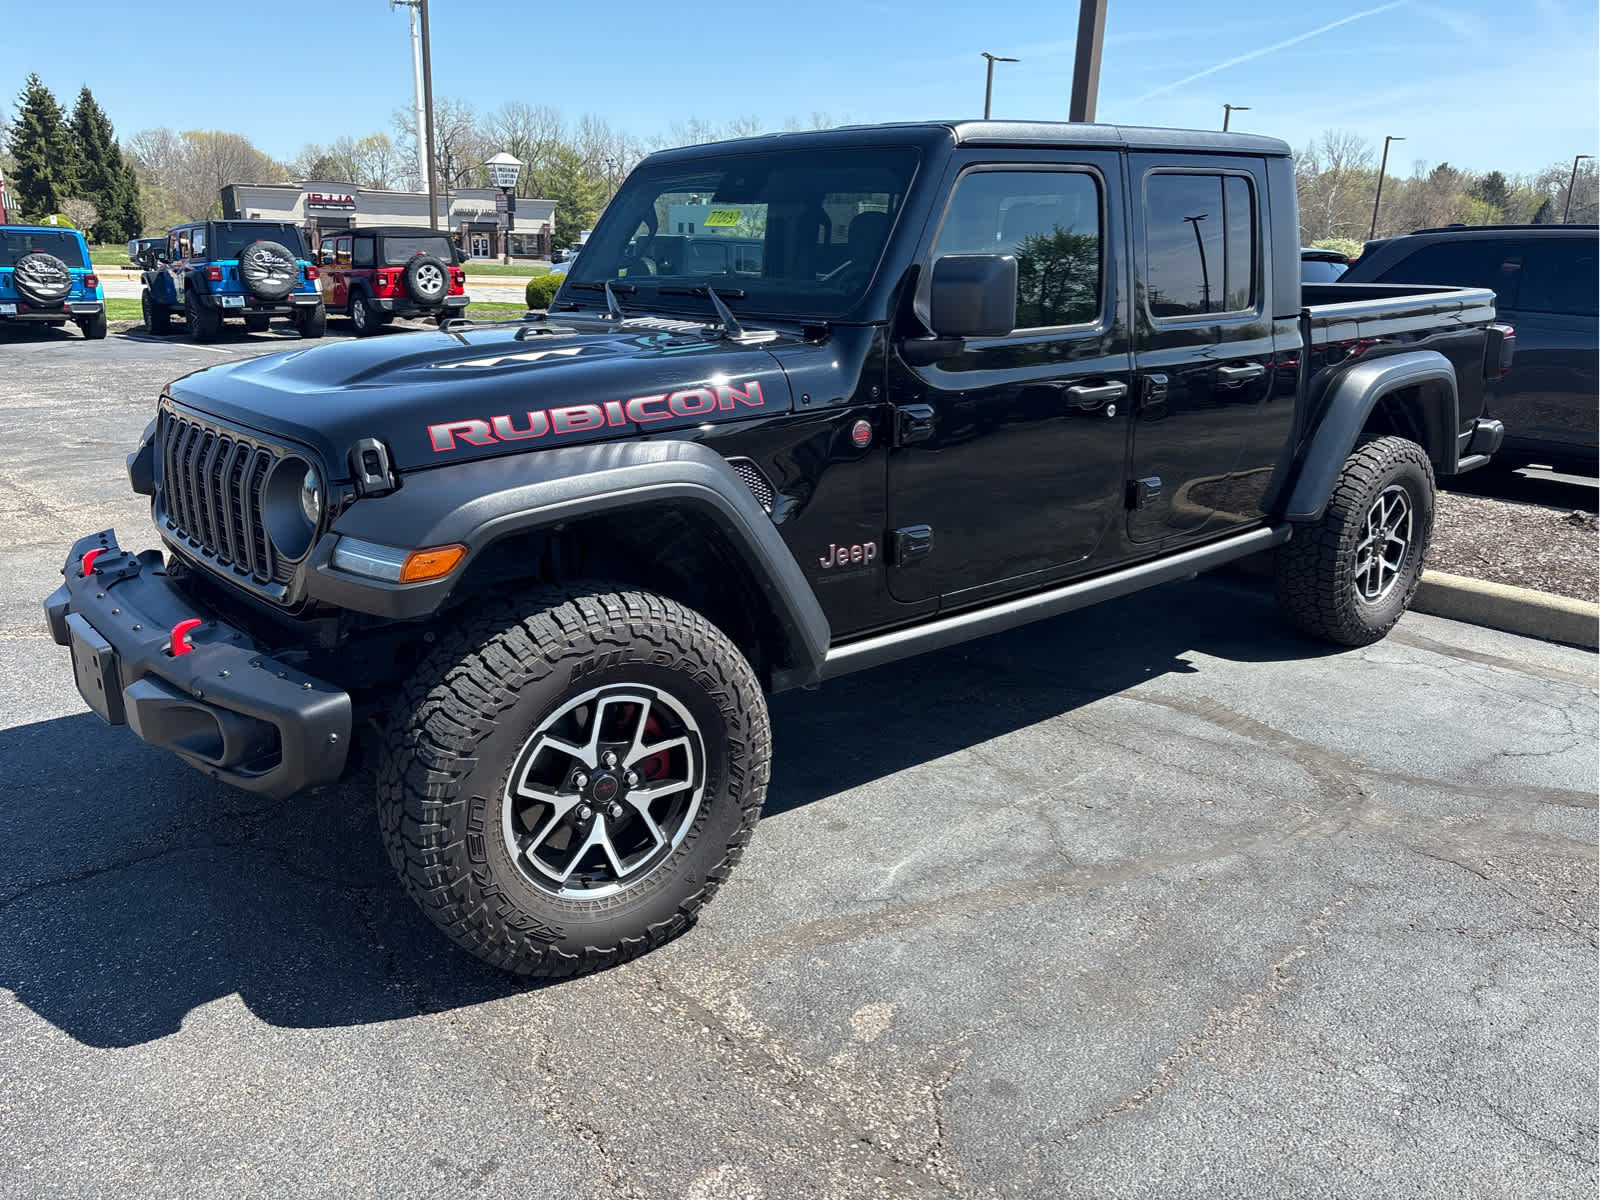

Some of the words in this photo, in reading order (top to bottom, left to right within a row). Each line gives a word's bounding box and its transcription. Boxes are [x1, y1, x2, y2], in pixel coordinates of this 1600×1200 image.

[427, 381, 765, 452] RUBICON
[819, 541, 877, 568] Jeep
[569, 648, 741, 731] WILDPEAK
[466, 794, 568, 945] FALKEN
